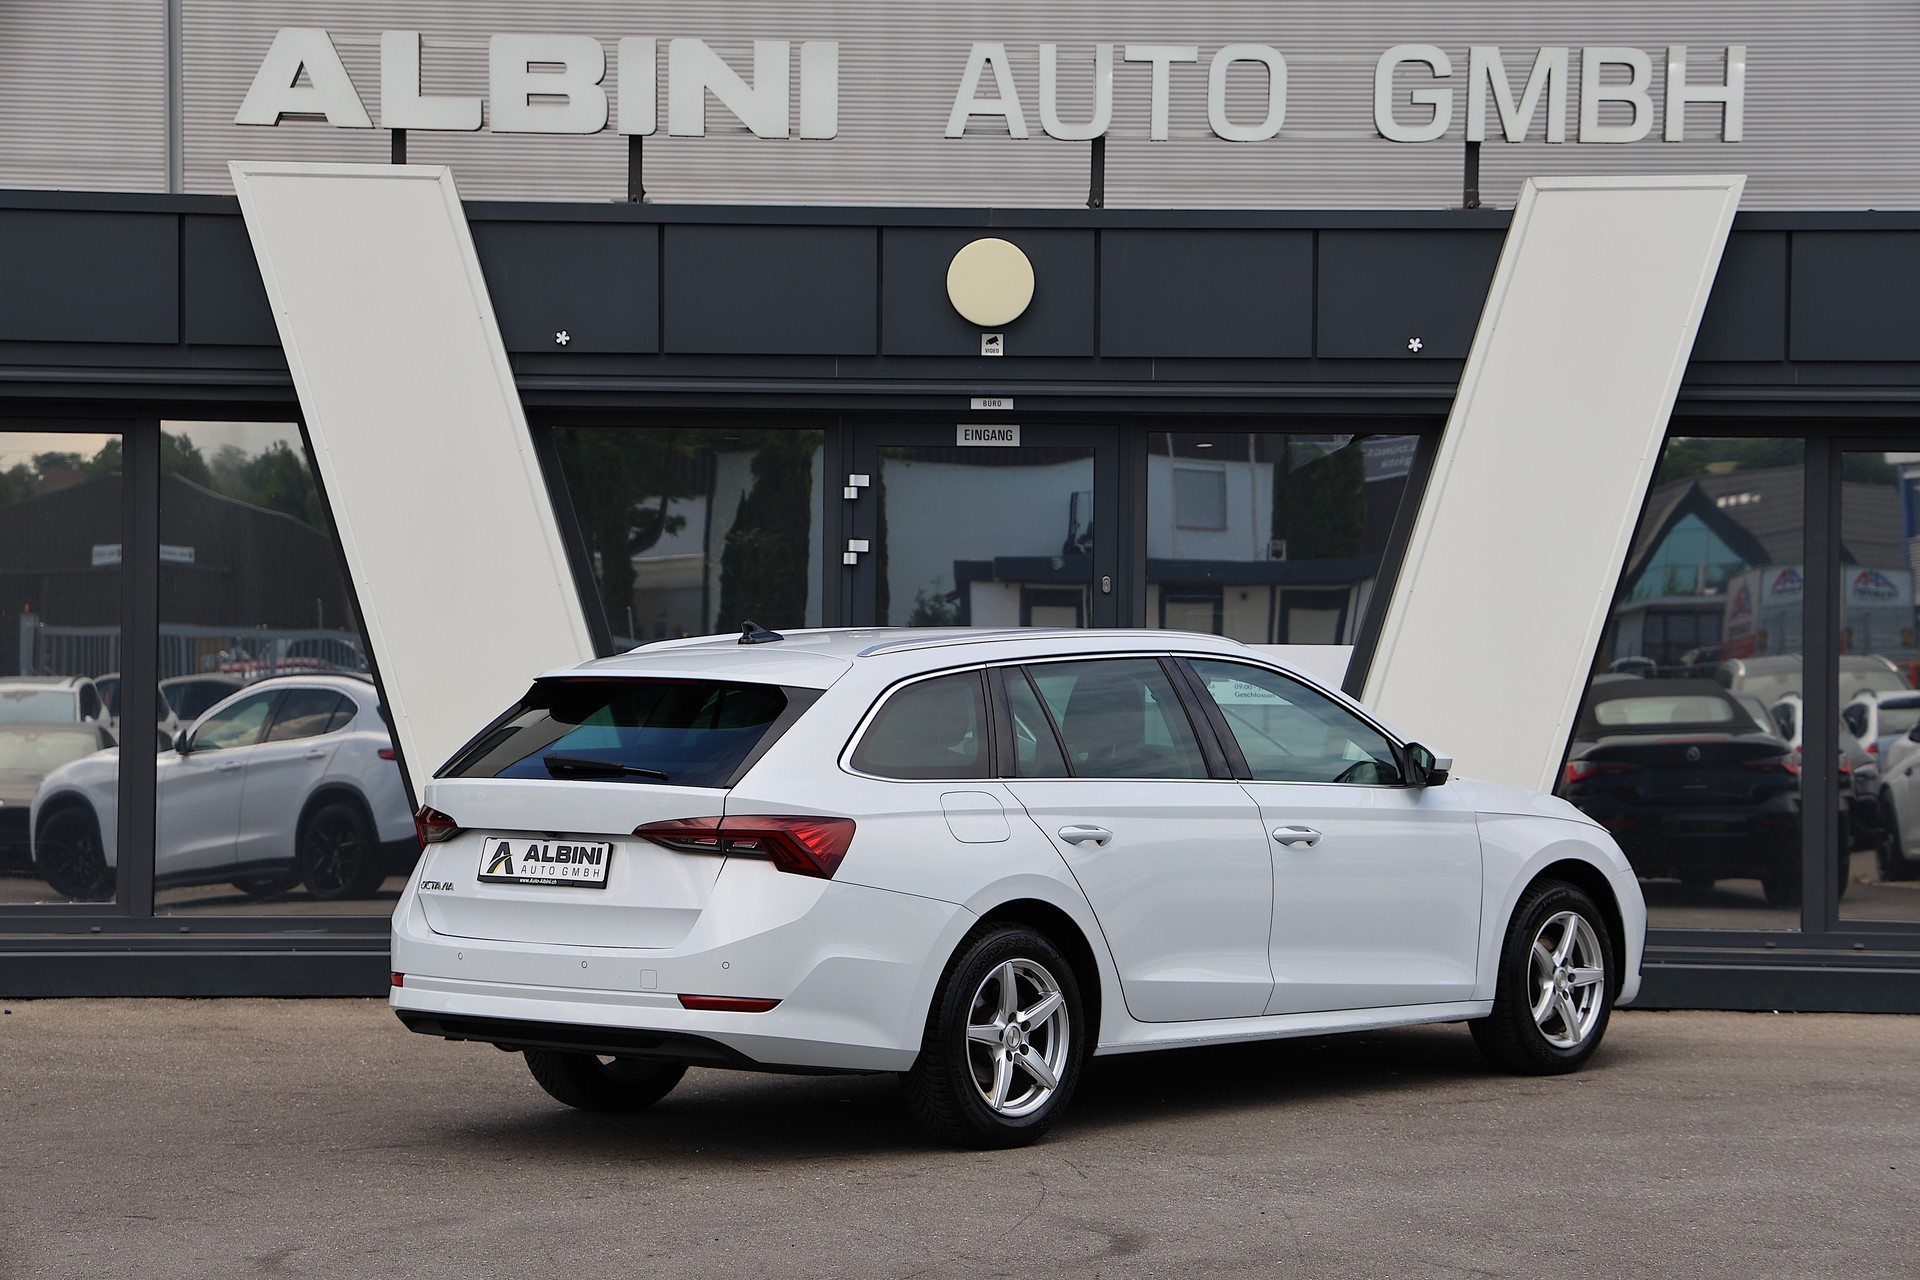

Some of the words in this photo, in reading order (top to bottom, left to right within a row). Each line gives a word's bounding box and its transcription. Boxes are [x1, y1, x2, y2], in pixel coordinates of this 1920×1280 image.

[234, 28, 840, 140] ALBINI
[944, 42, 1289, 142] AUTO
[1373, 44, 1746, 144] GMBH
[982, 399, 1002, 407] BÜRO
[964, 429, 1013, 441] EINGANG
[523, 844, 603, 866] ALBINI
[520, 864, 556, 876] AUTO
[561, 866, 600, 878] GMBH
